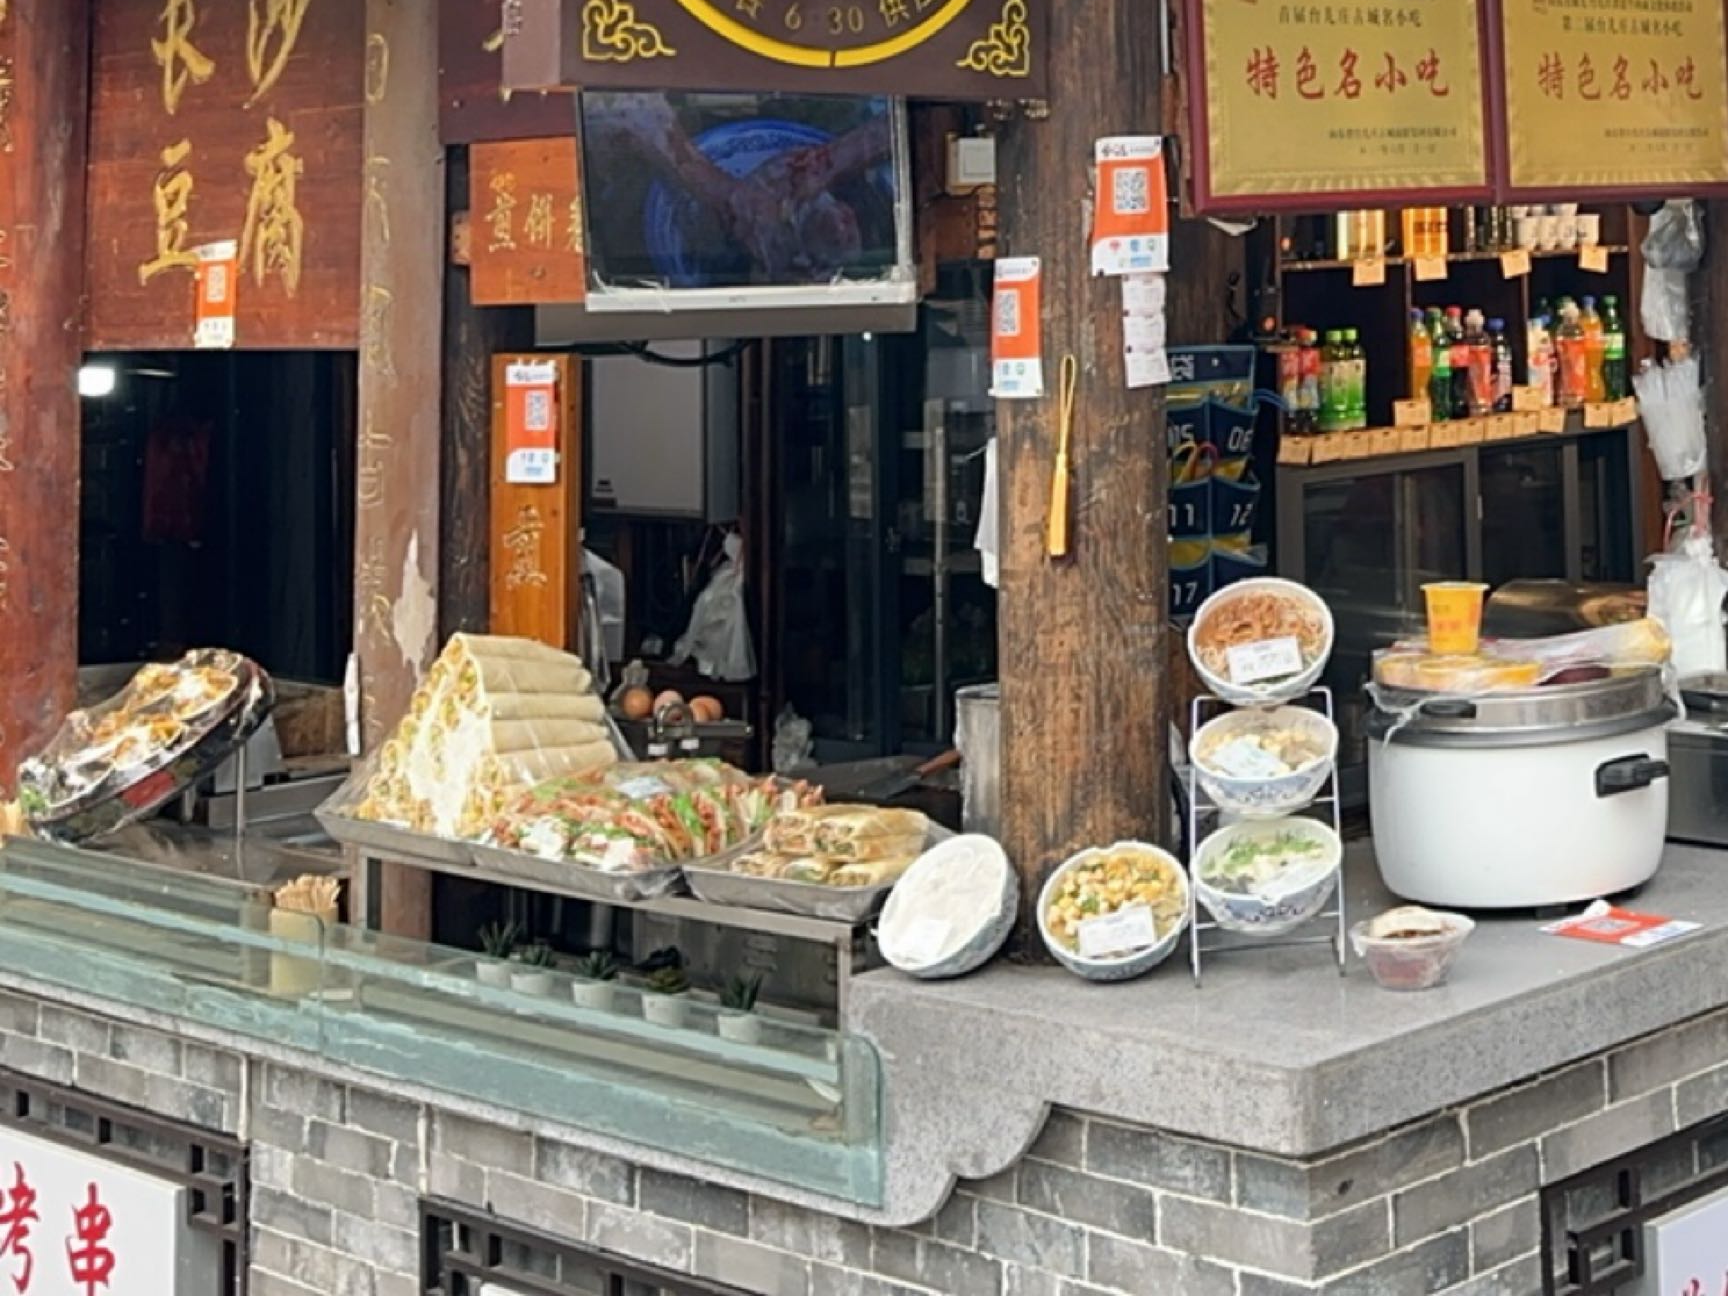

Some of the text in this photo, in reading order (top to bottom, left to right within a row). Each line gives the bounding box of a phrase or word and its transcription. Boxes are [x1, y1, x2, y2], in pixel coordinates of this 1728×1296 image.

[1246, 45, 1449, 100] 特色名小吃
[1538, 50, 1702, 100] 特色名小吃
[138, 116, 304, 300] 豆腐
[1173, 582, 1198, 606] 17
